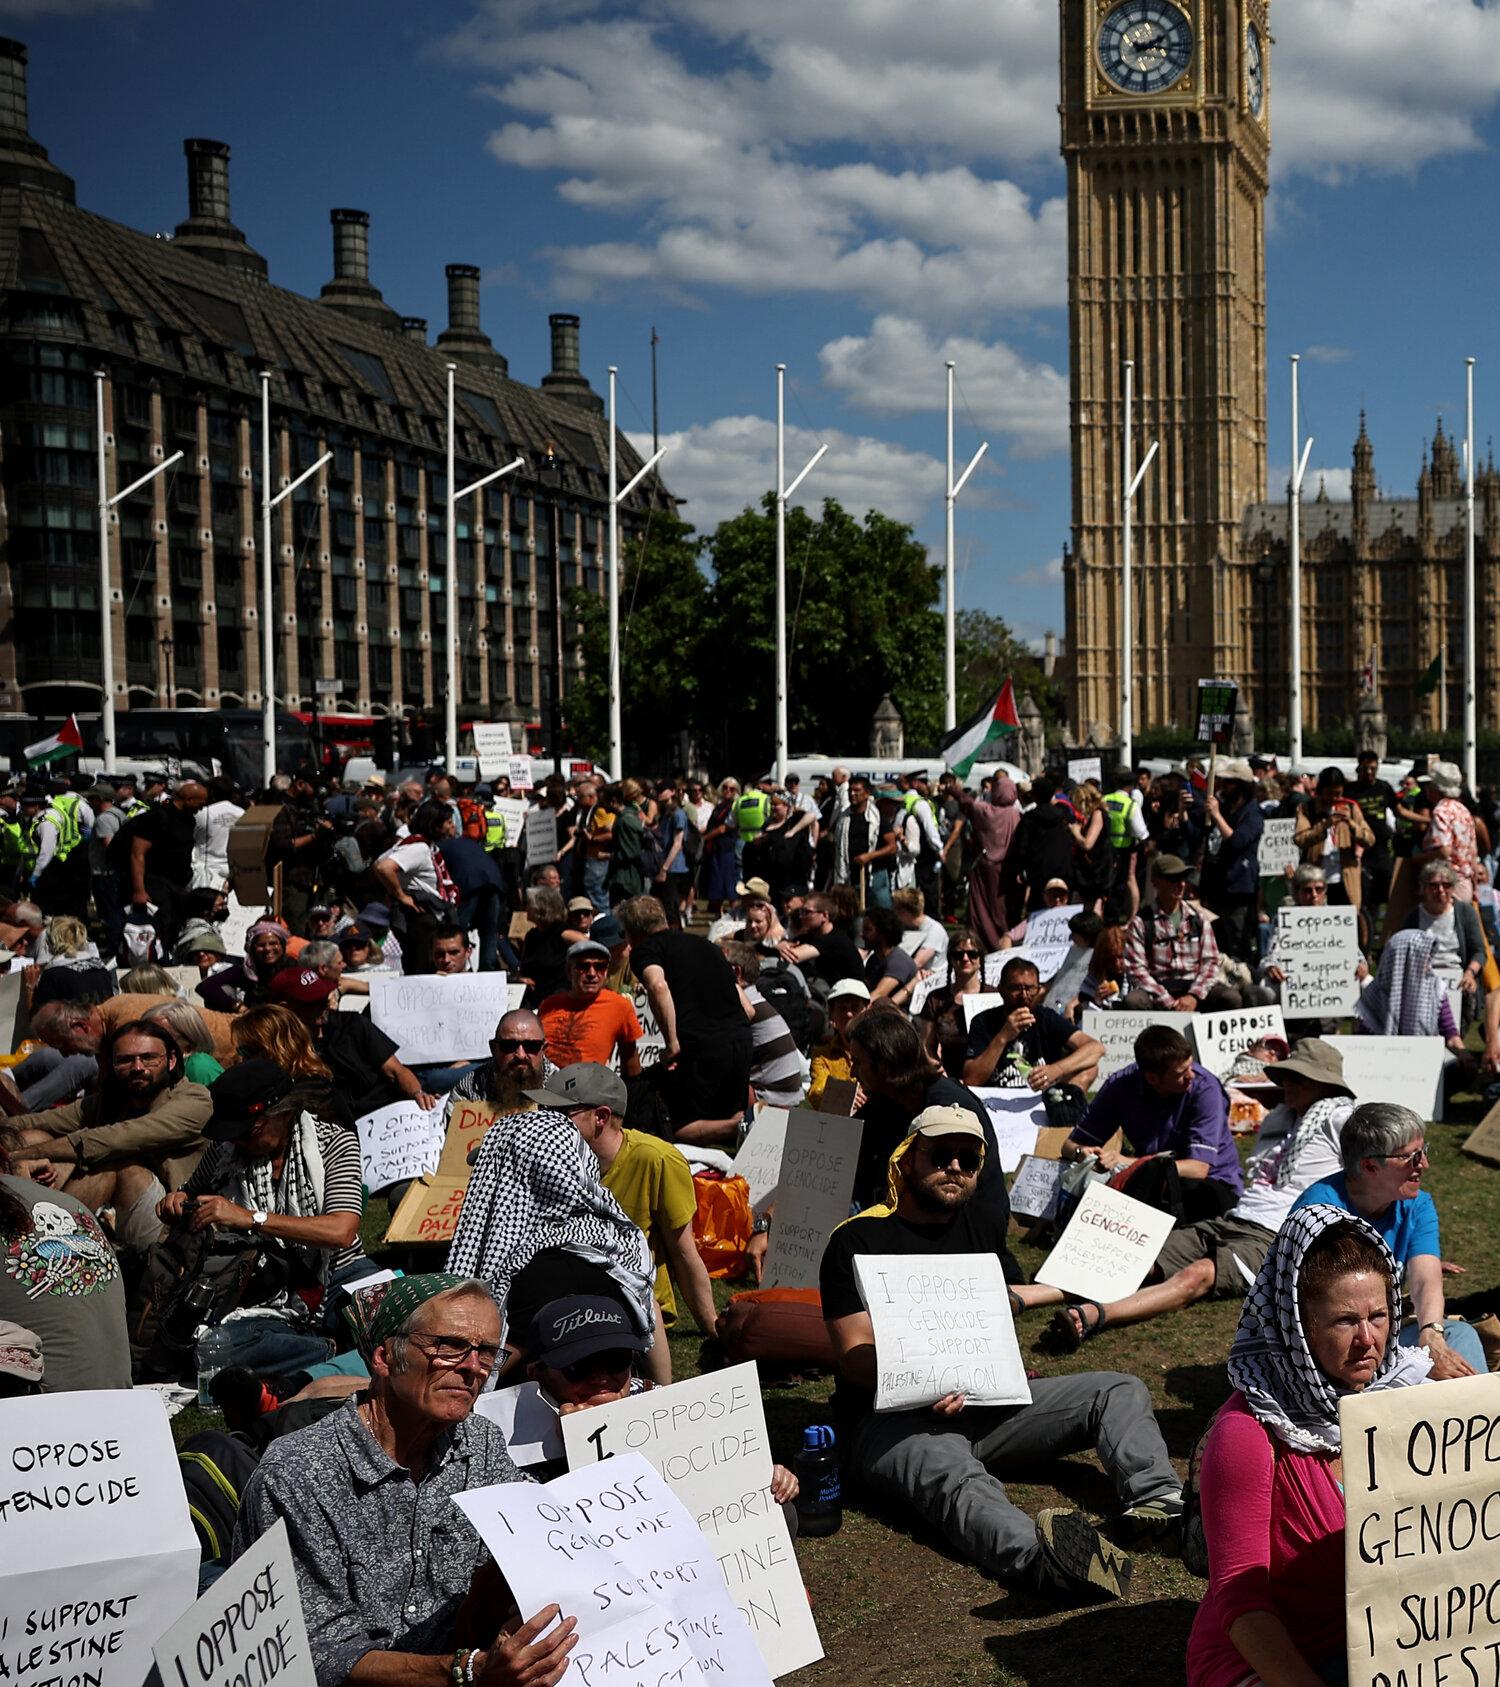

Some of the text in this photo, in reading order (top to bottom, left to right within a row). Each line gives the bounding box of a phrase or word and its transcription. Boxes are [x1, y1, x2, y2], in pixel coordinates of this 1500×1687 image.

[1280, 911, 1355, 935] I oppose
[1279, 934, 1346, 951] Genocide
[1277, 958, 1351, 977] I support
[1285, 976, 1349, 992] Palestine
[380, 984, 391, 1018] I
[1288, 992, 1343, 1009] Action
[1206, 1013, 1275, 1040] I OPPOSE
[818, 1120, 828, 1144] I
[788, 1147, 843, 1173] OPPOSE
[786, 1169, 840, 1197] GENOCIDE
[779, 1221, 823, 1243] SUPPORT
[1080, 1208, 1151, 1248] GENOCIDE
[775, 1239, 815, 1263] PALESTINE
[770, 1262, 805, 1281] ACTION
[877, 1271, 980, 1304] I OPPOSE
[552, 1308, 622, 1342] Titleist
[908, 1308, 989, 1331] GENOCIDE
[896, 1337, 992, 1364] I SUPPORT
[881, 1364, 998, 1397] PALESTINE ACTION
[587, 1385, 751, 1462] I OPPOSE
[11, 1439, 121, 1473] OPPOSE
[1363, 1425, 1379, 1491] I
[496, 1475, 654, 1535] I OPPOSE
[545, 1510, 673, 1561] GENOCIDE
[592, 1559, 701, 1611] SUPPORT
[24, 1594, 139, 1636] SUPPORT
[196, 1560, 285, 1682] OPPOSE
[1364, 1605, 1375, 1658] I
[571, 1614, 724, 1687] PALESTINE
